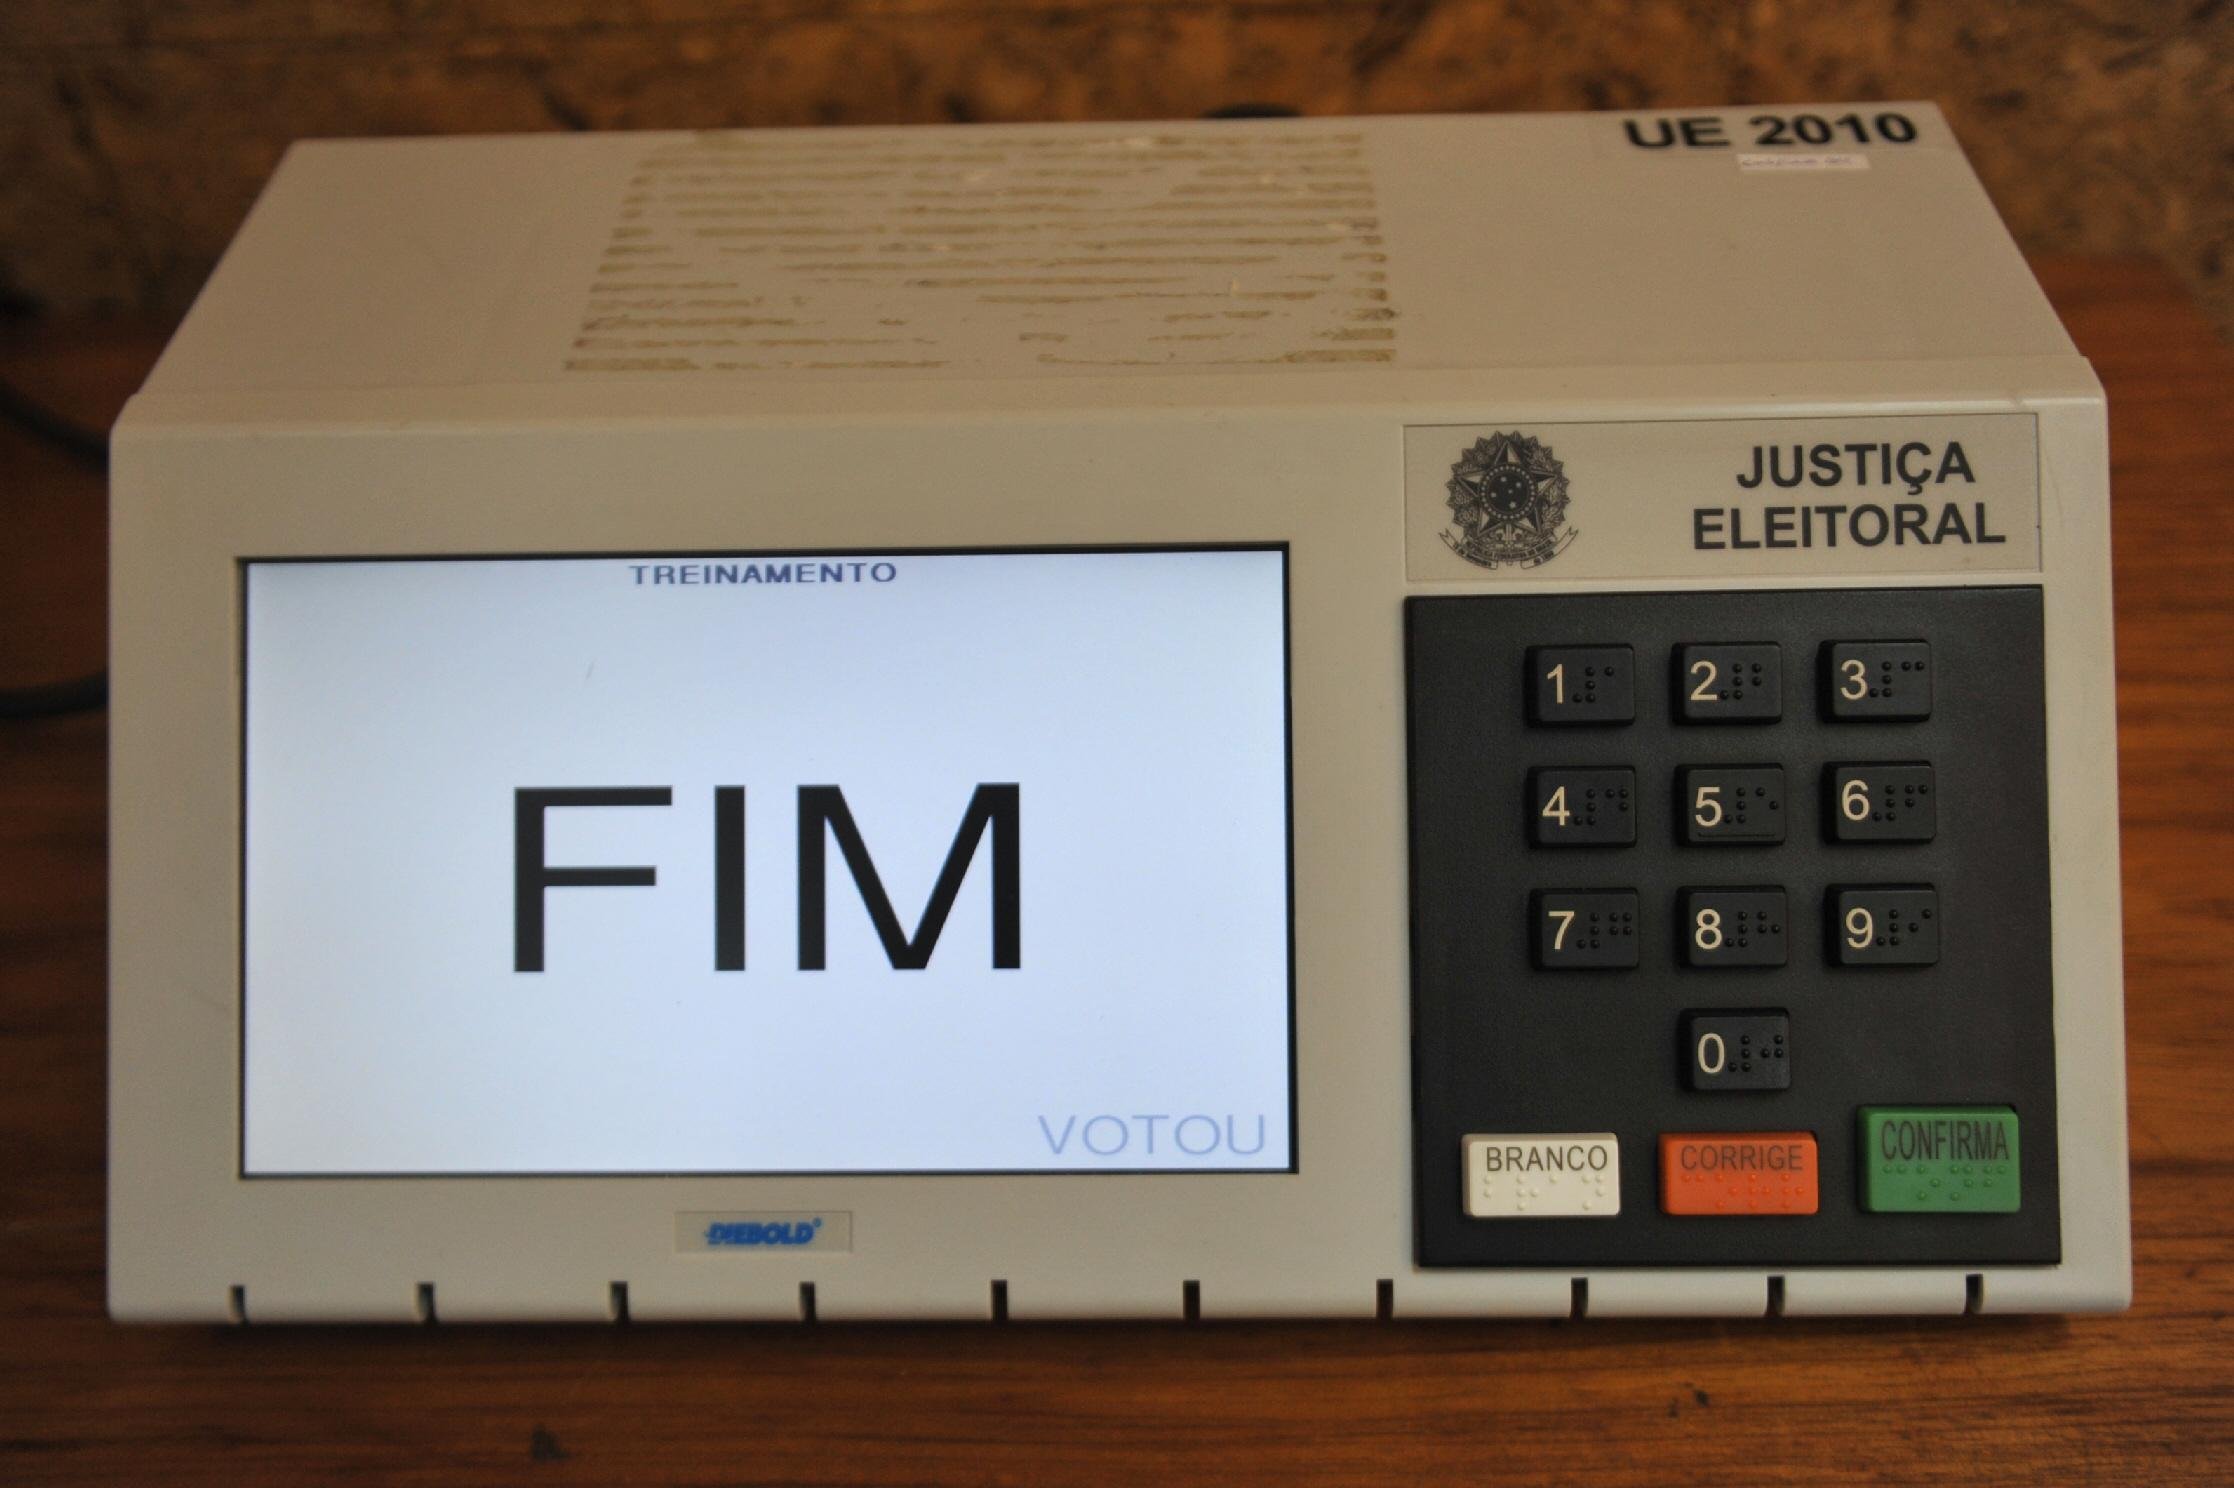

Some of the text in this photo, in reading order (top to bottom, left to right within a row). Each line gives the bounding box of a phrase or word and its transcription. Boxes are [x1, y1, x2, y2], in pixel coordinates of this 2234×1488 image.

[1624, 112, 1917, 148] UE 2010
[1736, 441, 1976, 495] JUSTIÇA
[1694, 502, 2007, 550] ELEITORAL
[629, 561, 898, 586] TREINAMENTO
[1546, 663, 1564, 704] 1
[1690, 660, 1718, 701] 2
[1840, 659, 1867, 700] 3
[1542, 786, 1570, 826] 4
[1695, 786, 1722, 827] 5
[1841, 779, 1870, 821] 6
[514, 782, 1021, 973] FIM
[1548, 910, 1575, 950] 7
[1695, 908, 1722, 950] 8
[1845, 908, 1874, 948] 9
[1697, 1033, 1725, 1074] 0
[1038, 1114, 1266, 1156] VOTOU
[1881, 1119, 2009, 1160] CONFIRMA
[1486, 1145, 1608, 1172] BRANCO
[1680, 1145, 1804, 1171] CORRIGE
